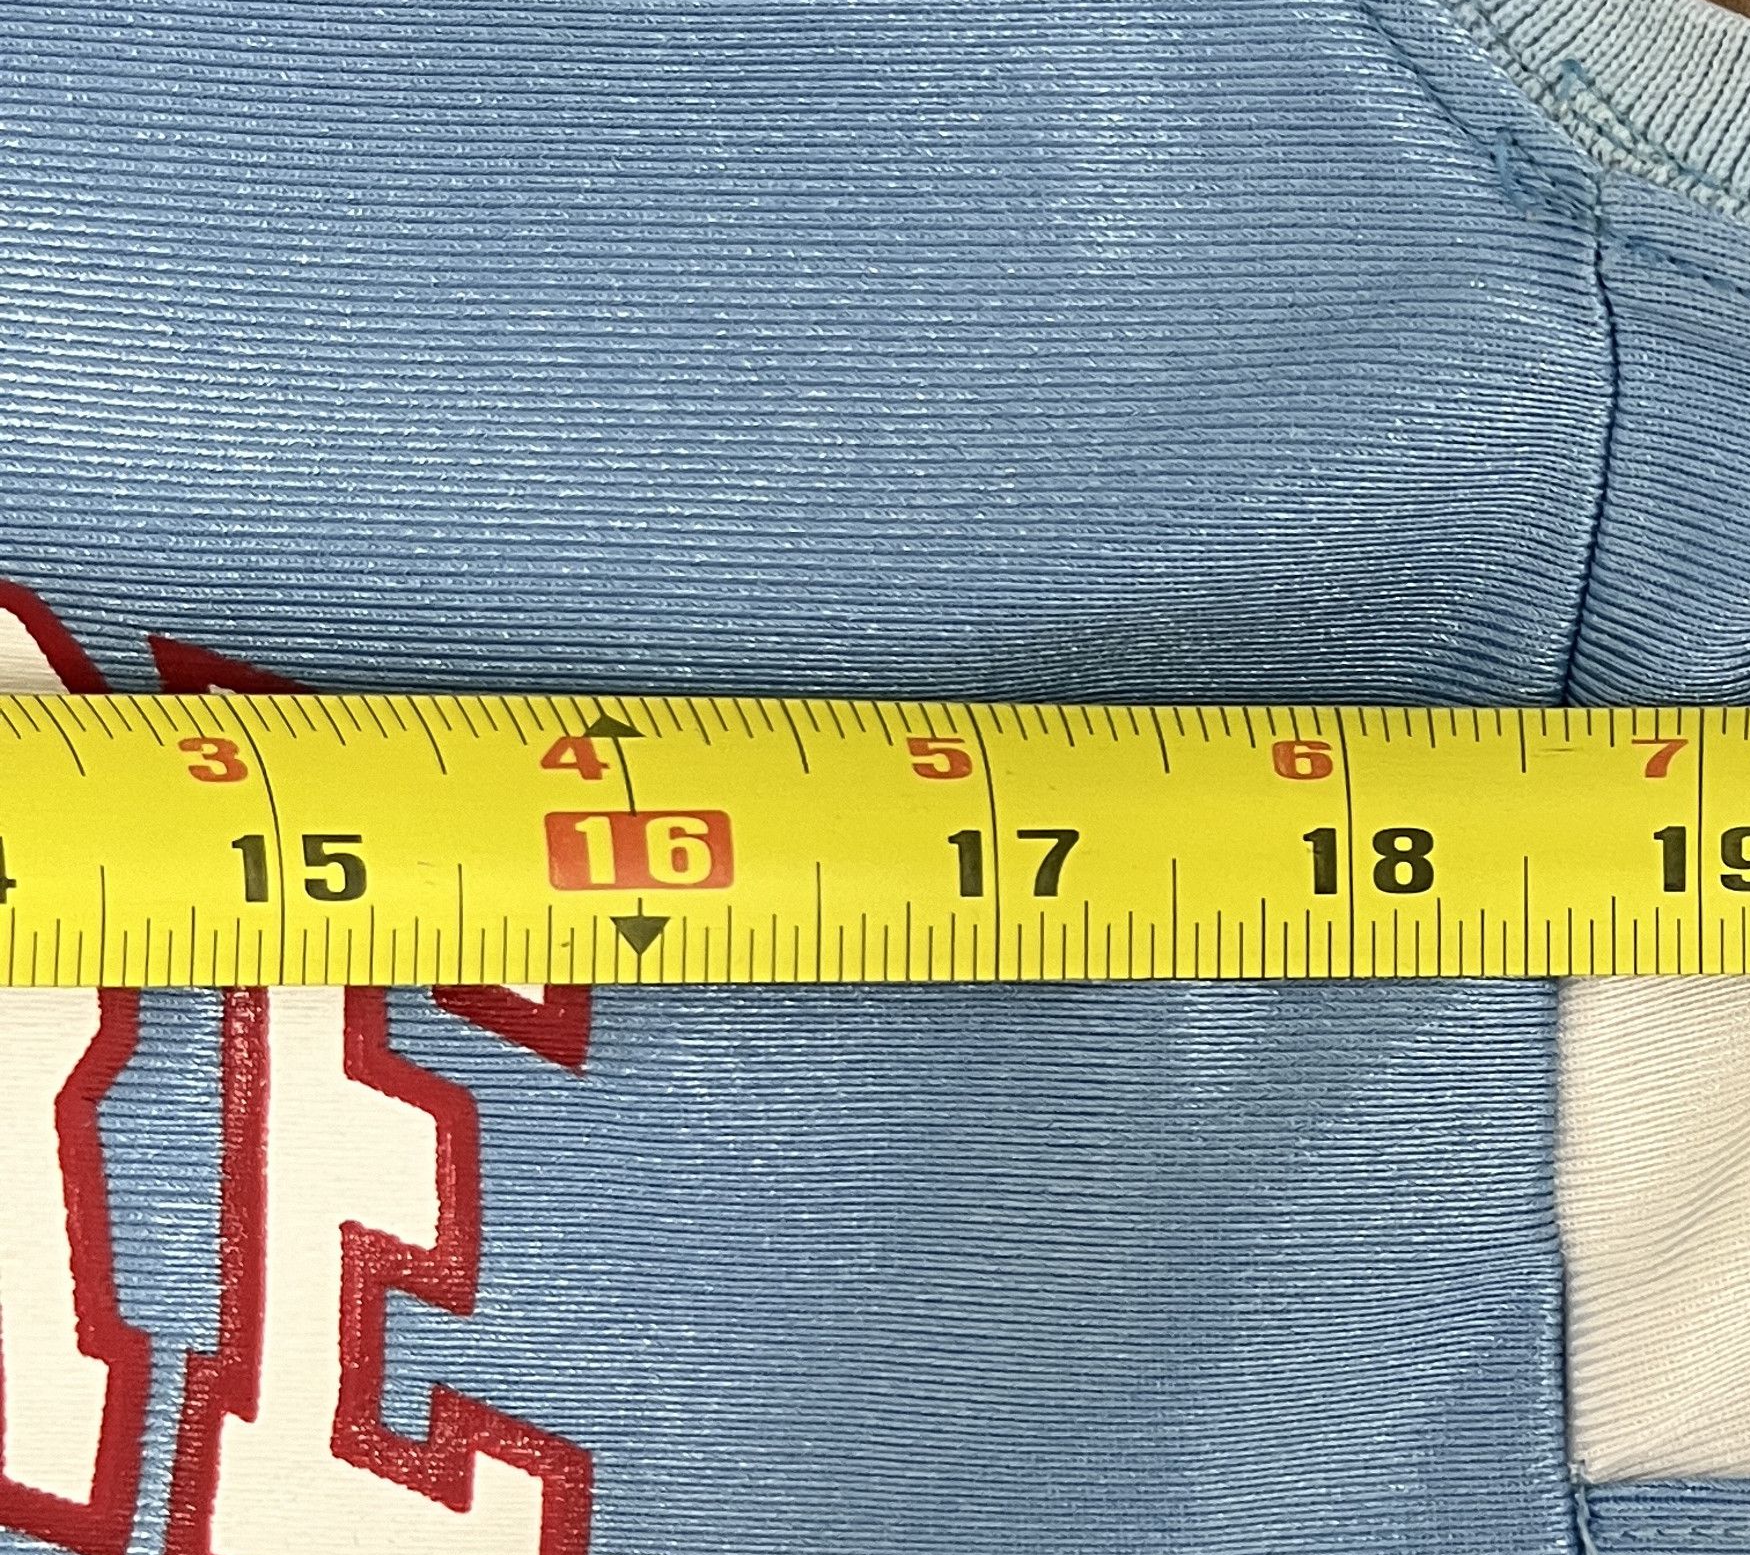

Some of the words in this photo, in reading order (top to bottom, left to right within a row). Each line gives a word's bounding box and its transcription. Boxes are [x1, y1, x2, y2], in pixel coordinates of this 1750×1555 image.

[178, 739, 249, 782] 3
[541, 736, 608, 780] 4
[911, 738, 973, 779] 5
[1271, 740, 1334, 780] 6
[1632, 738, 1689, 779] 7
[231, 834, 367, 902] 15
[575, 816, 711, 886] 16
[947, 829, 1081, 898] 17
[1303, 827, 1435, 895] 18
